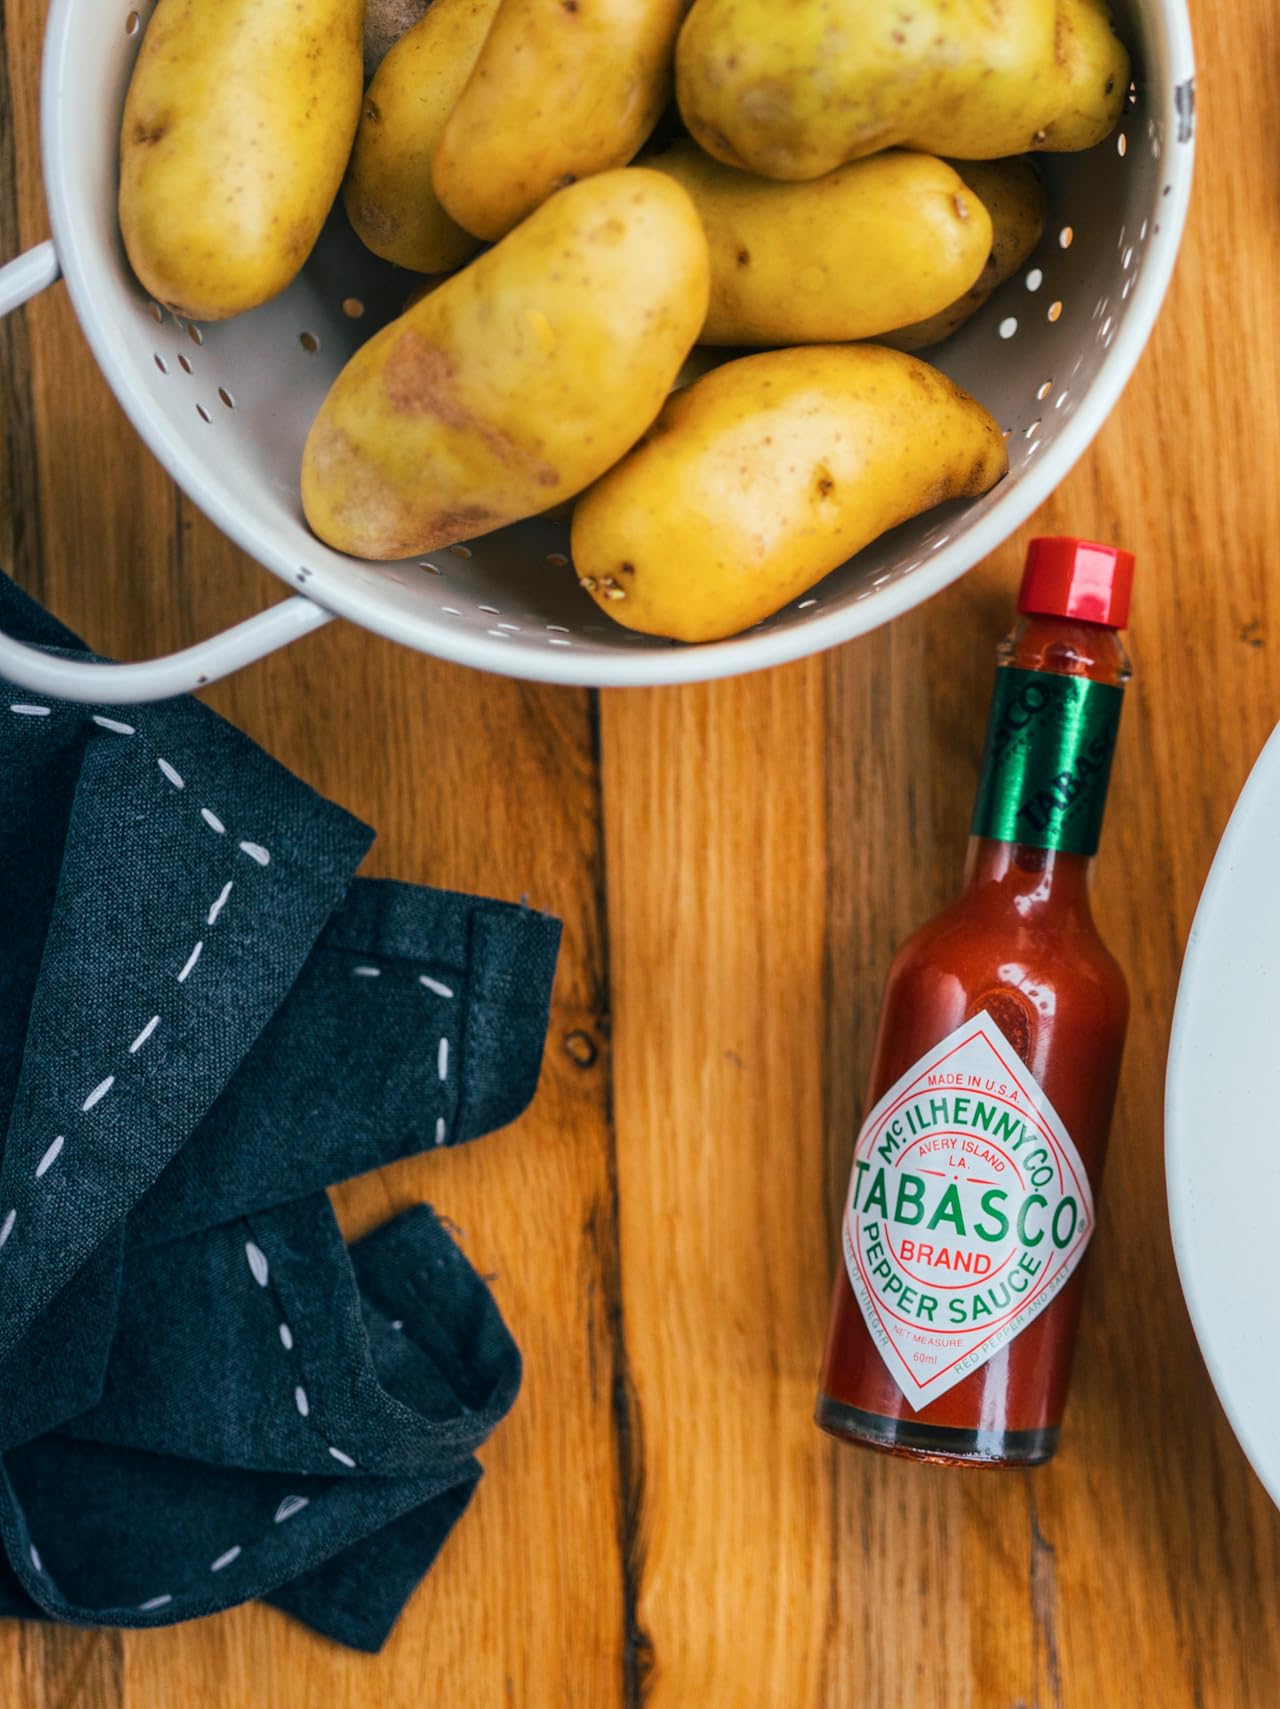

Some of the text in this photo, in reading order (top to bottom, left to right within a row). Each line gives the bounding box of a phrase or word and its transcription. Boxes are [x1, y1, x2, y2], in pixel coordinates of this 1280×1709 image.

[927, 1073, 1021, 1104] MADE IN U.S.A.
[905, 1097, 1038, 1152] ILHENNY
[1022, 1148, 1054, 1193] CO.
[918, 1138, 1006, 1172] AVERY ISLAND
[948, 1155, 970, 1170] LA.
[852, 1159, 1078, 1249] TABASCO
[863, 1221, 939, 1322] PEPPER
[948, 1251, 1042, 1324] SAUCE
[899, 1239, 992, 1276] BRAND
[893, 1324, 965, 1348] NET MEASURE
[953, 1263, 1072, 1375] RED PEPPER AND SALT
[912, 1351, 938, 1365] 60ml
